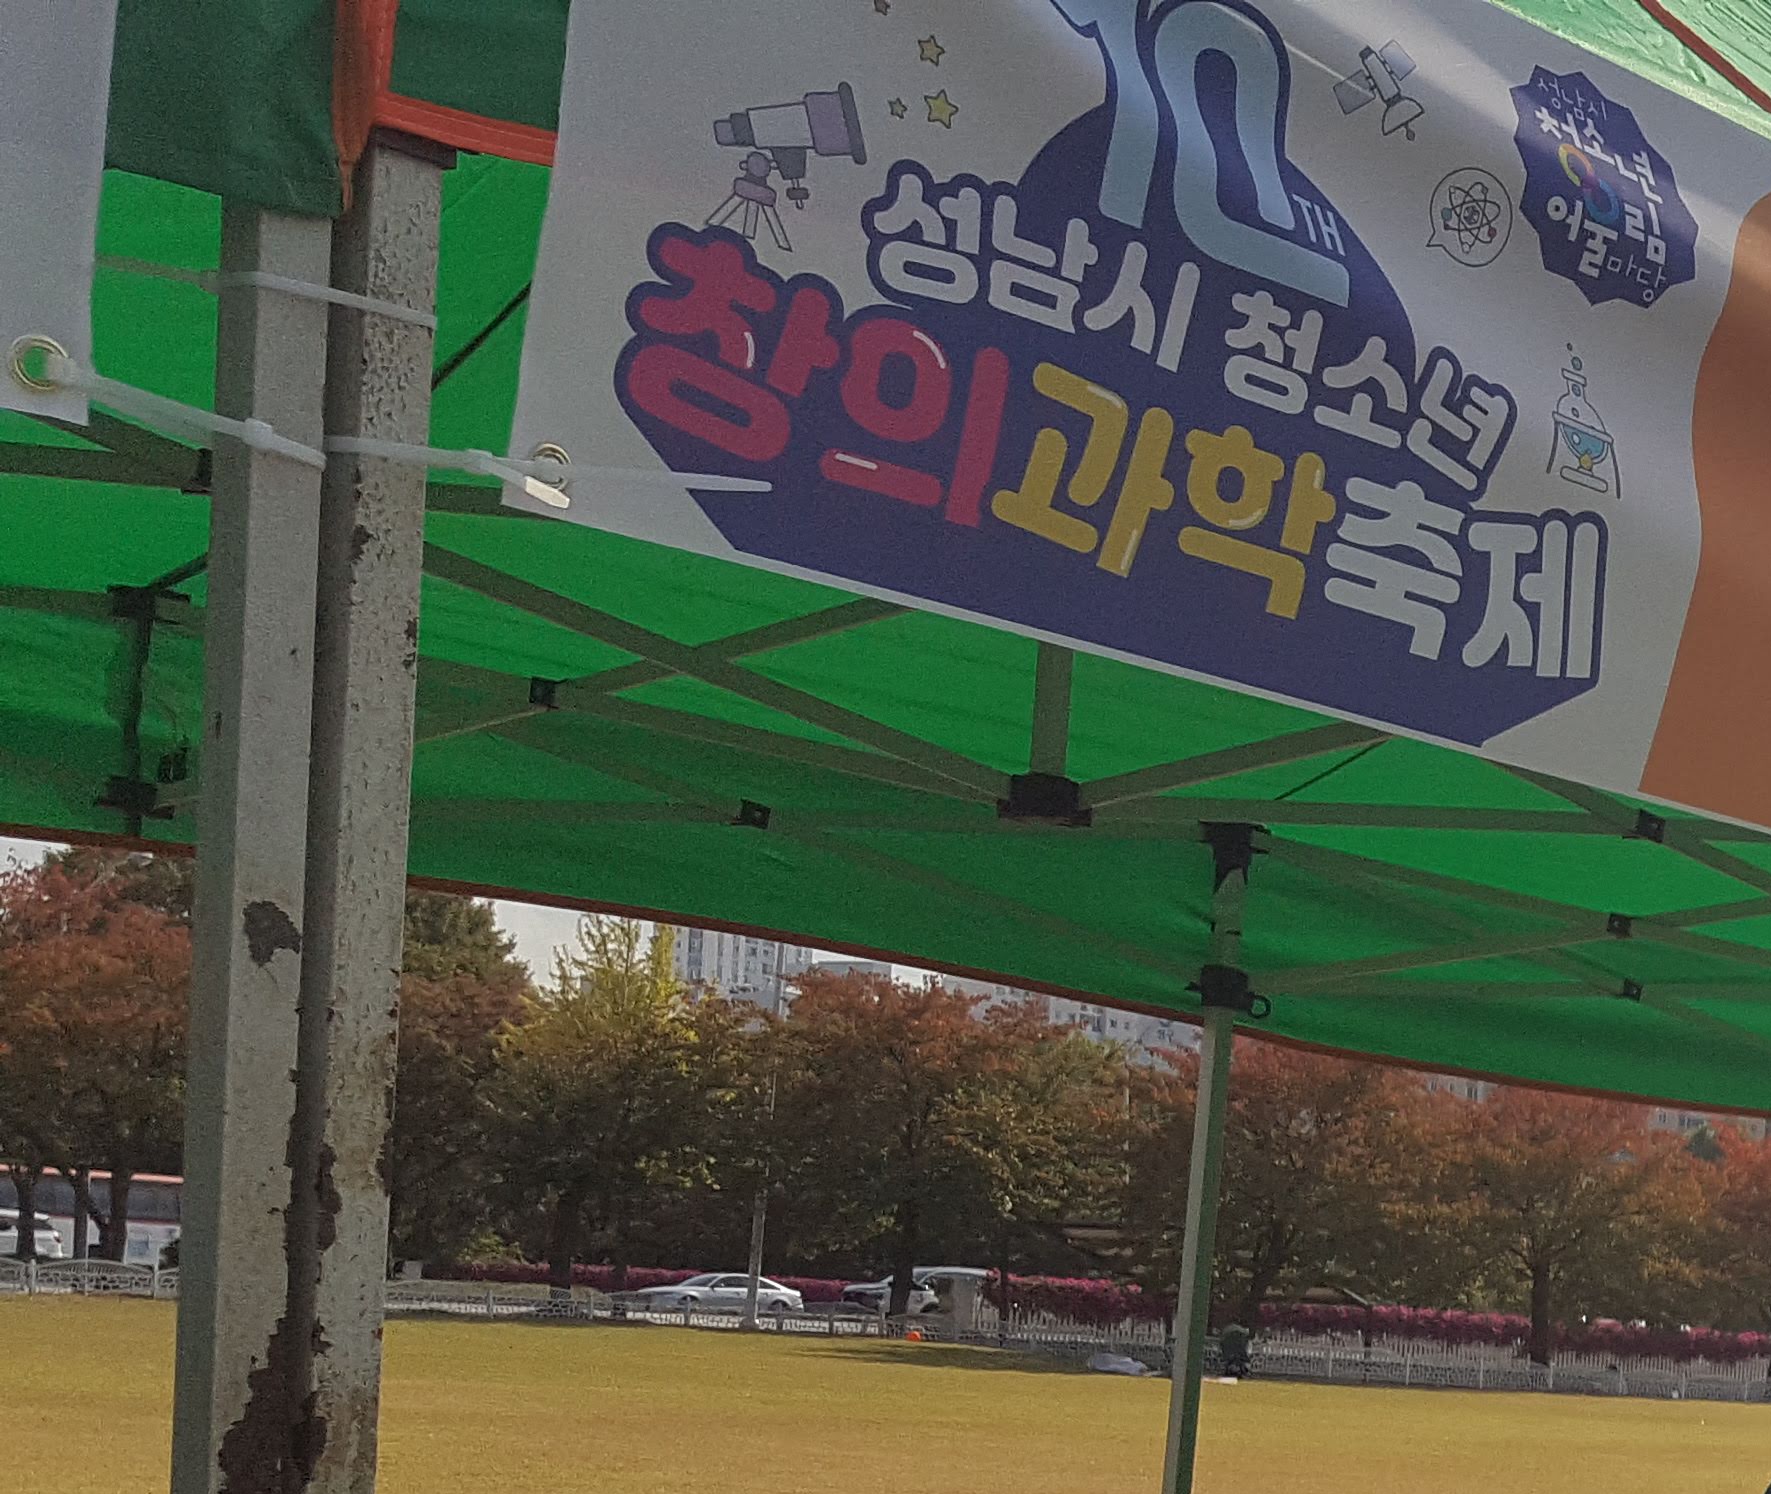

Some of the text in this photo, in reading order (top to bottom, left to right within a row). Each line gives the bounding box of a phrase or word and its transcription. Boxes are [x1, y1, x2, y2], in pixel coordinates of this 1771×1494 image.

[1537, 77, 1607, 121] 성남시
[1535, 106, 1664, 205] 청소년
[868, 173, 1512, 491] 성남시 청소년
